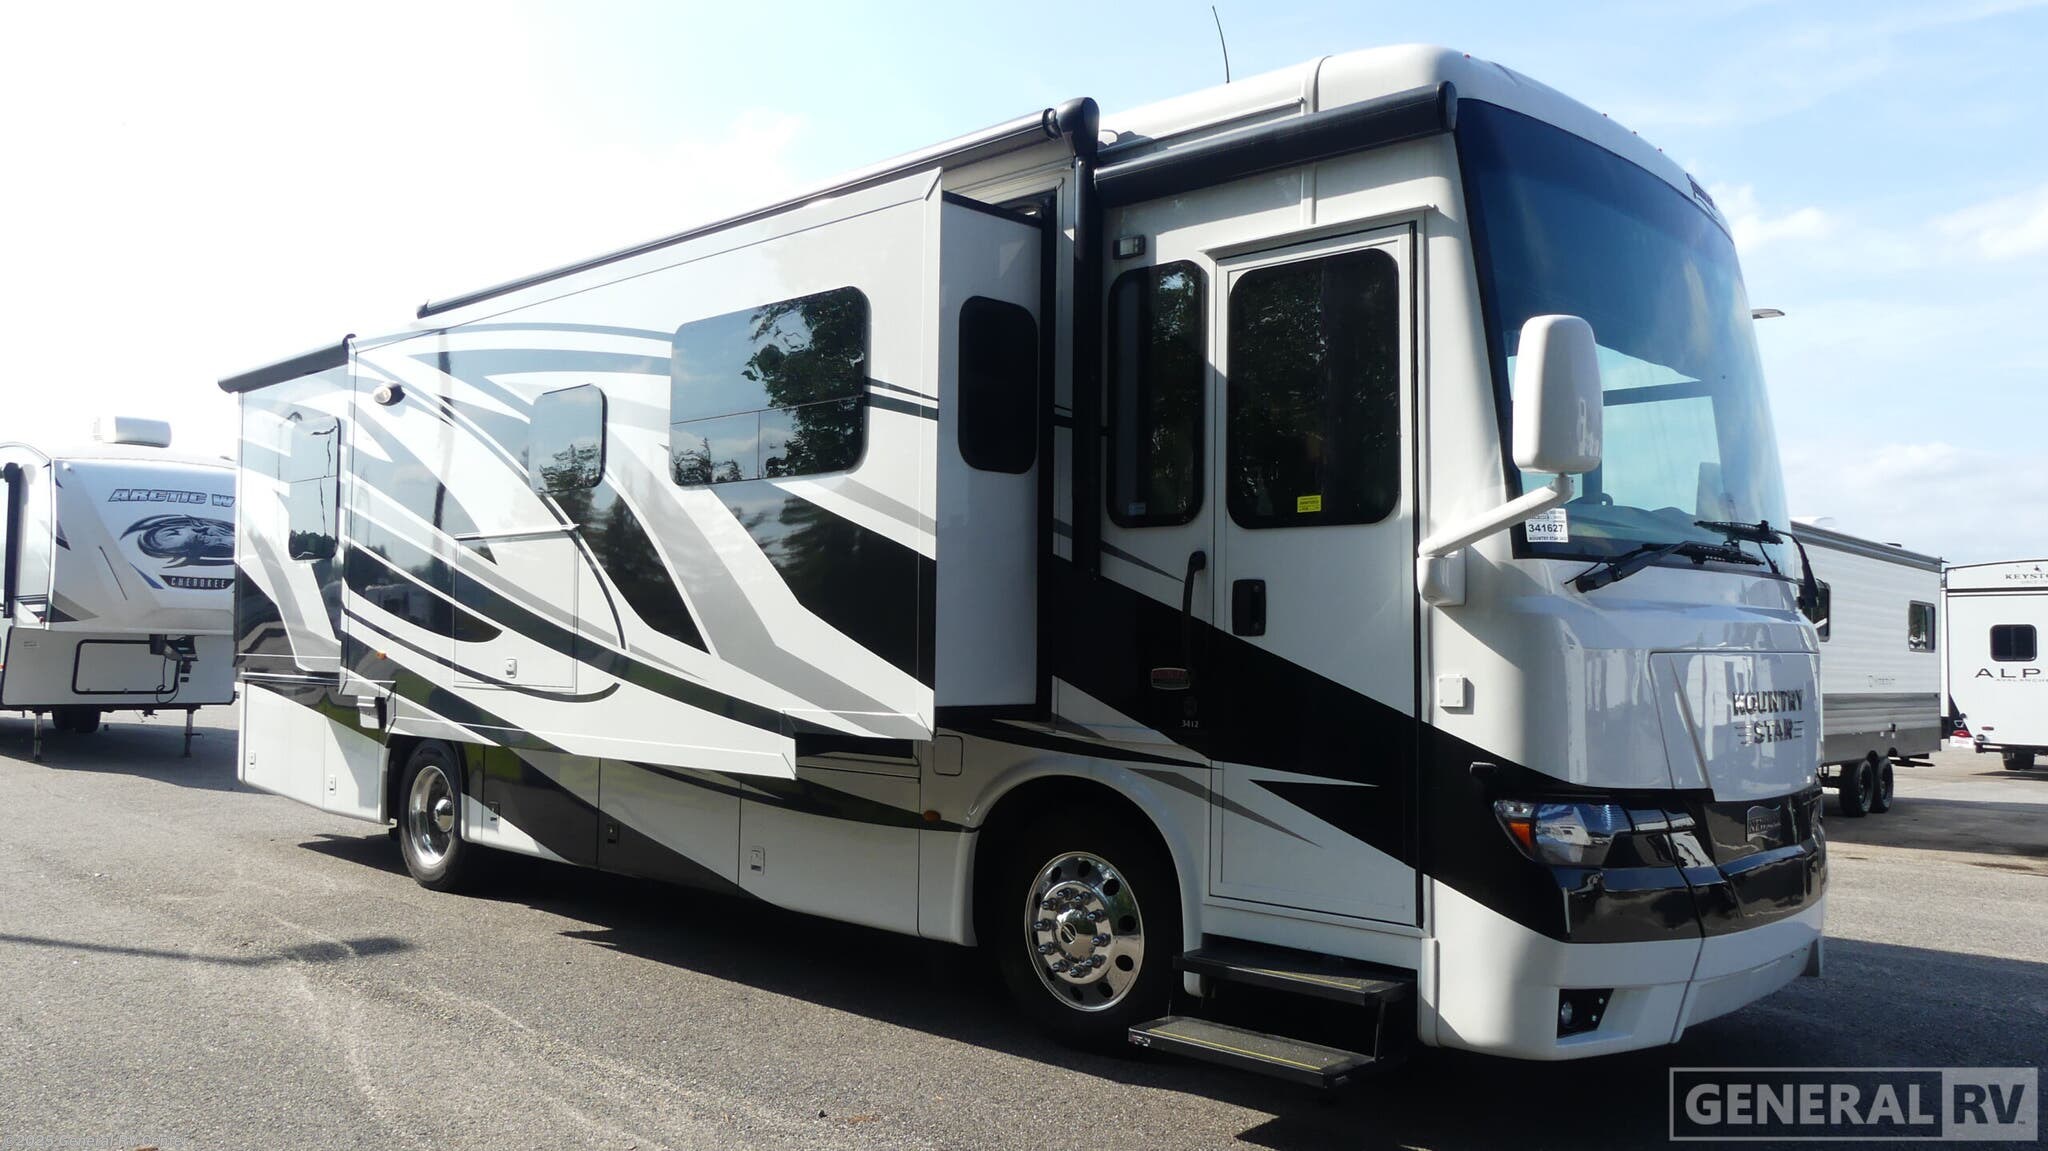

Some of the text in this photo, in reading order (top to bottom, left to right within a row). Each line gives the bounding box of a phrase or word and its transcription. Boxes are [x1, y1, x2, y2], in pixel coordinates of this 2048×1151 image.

[108, 489, 207, 504] ARCTIC
[1528, 524, 1563, 532] 341627
[171, 577, 225, 588] CHEROKEE
[1975, 668, 2041, 678] ALP
[1733, 690, 1803, 716] KOUNTRY
[1754, 719, 1793, 744] STAR
